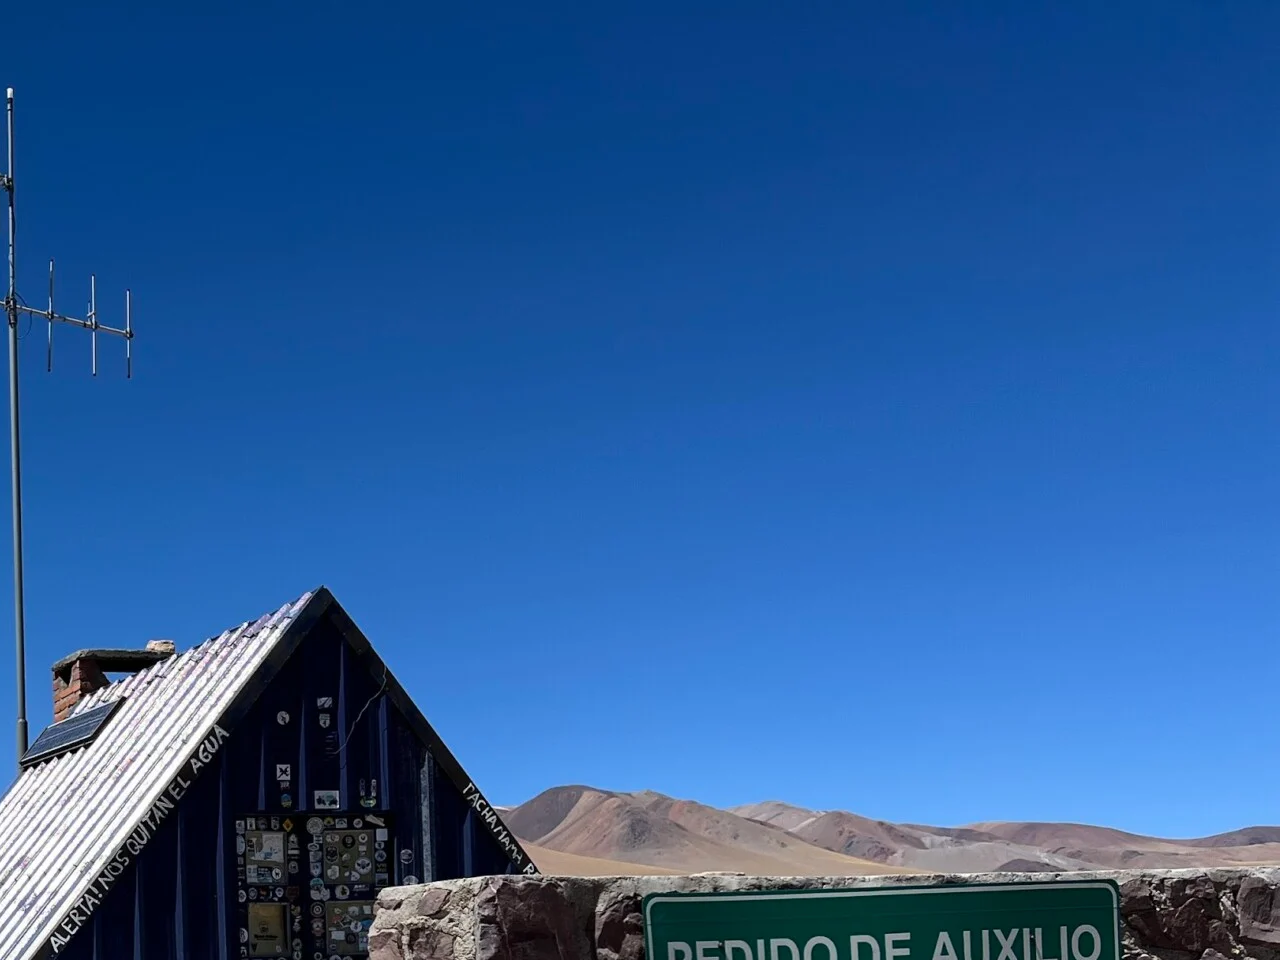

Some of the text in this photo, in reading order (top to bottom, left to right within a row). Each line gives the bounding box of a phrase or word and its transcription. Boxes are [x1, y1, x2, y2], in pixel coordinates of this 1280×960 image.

[49, 723, 230, 953] ALERTA! NOS QUITAN EL AGUA
[463, 782, 523, 864] PACHAMAMA
